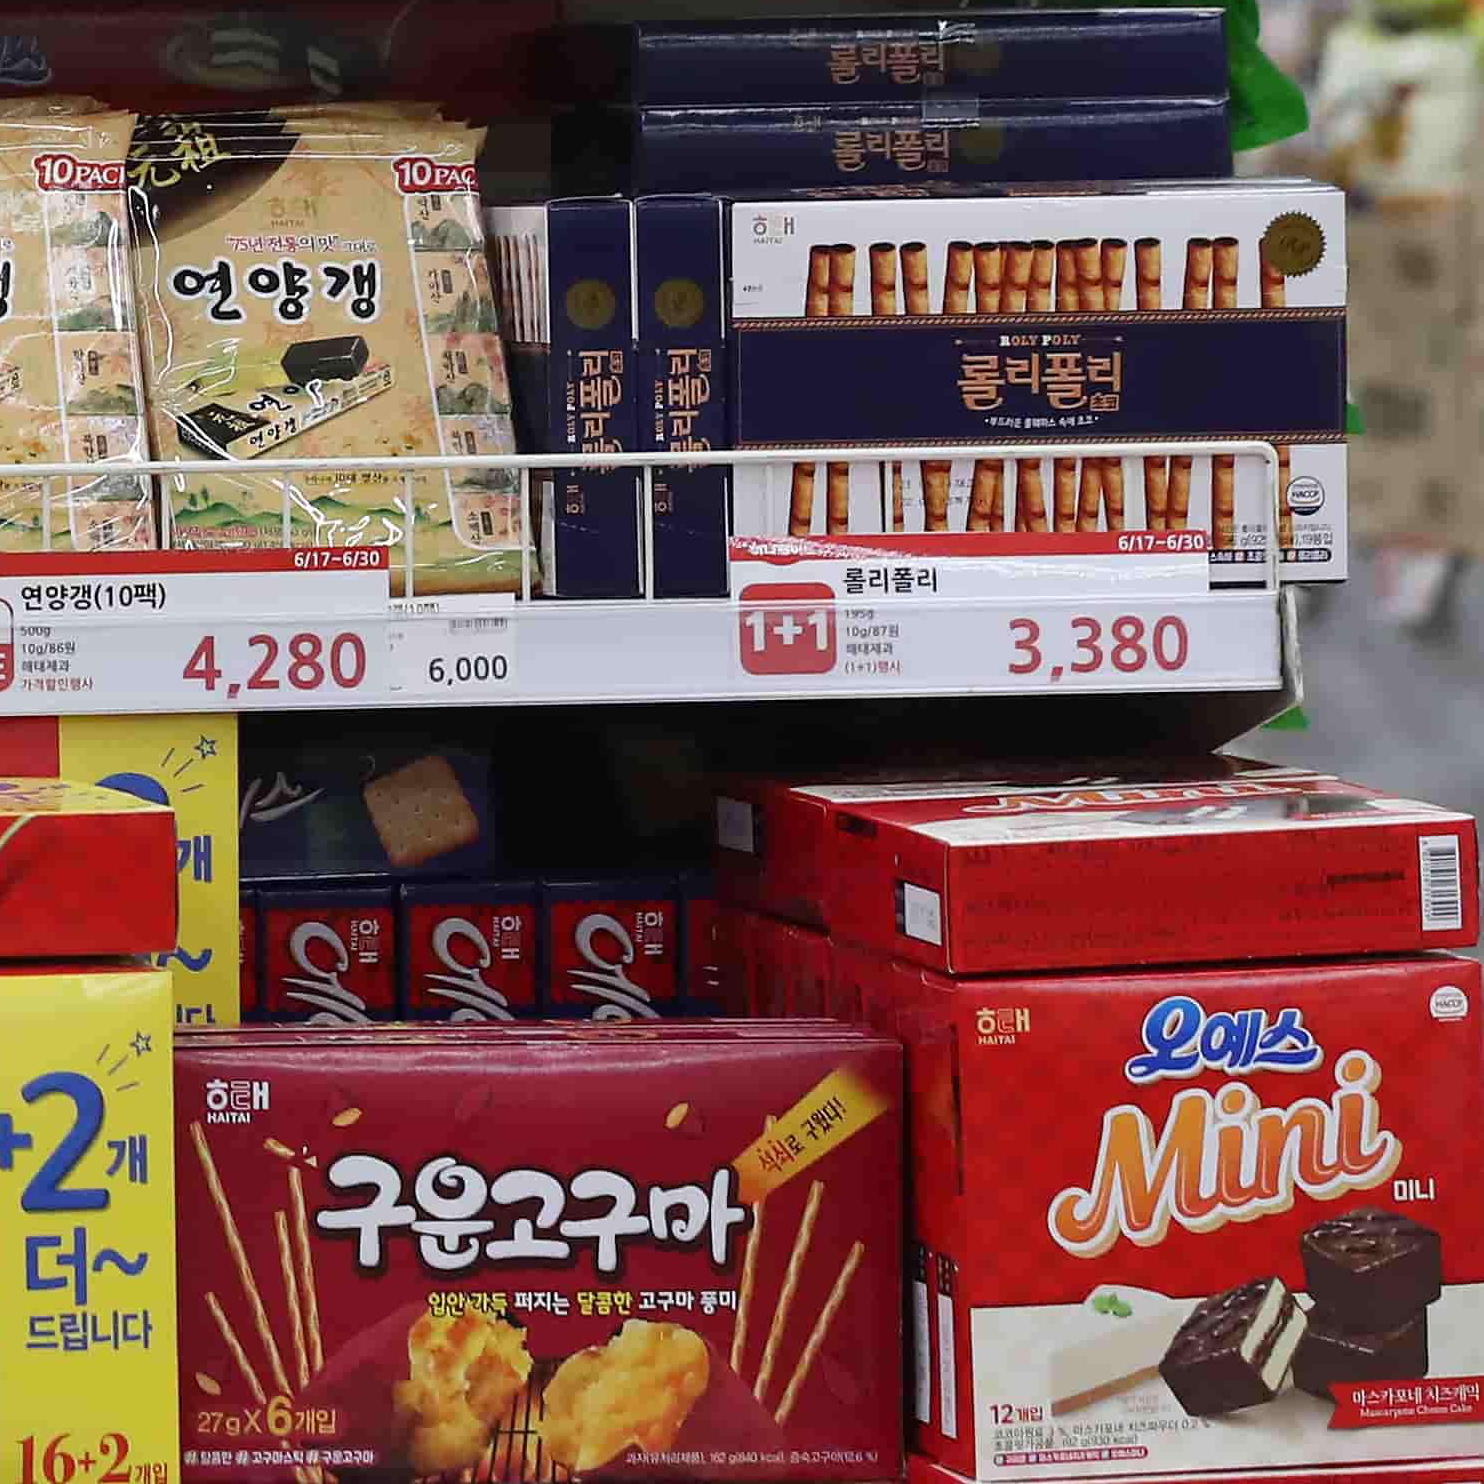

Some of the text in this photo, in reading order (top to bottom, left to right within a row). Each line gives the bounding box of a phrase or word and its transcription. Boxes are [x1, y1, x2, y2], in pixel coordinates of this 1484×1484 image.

[829, 42, 945, 84] 롤리폴리
[833, 128, 951, 172] 롤리폴리
[267, 235, 317, 253] 전통의
[173, 260, 377, 320] 연양갱
[999, 334, 1081, 346] ROLY POLY
[957, 351, 1123, 411] 롤리폴리
[1118, 532, 1205, 553] 6/17~6/30
[293, 549, 381, 570] 6/17~6/30
[843, 567, 938, 594] 롤리폴리
[21, 583, 167, 612] 연양갱(10팩)
[745, 610, 830, 653] 1+1
[1008, 614, 1190, 683] 3,380
[182, 630, 368, 700] 4,280
[428, 655, 508, 686] 6,000
[979, 1035, 1017, 1045] HAITAI
[1125, 996, 1321, 1083] 오예스
[207, 1113, 251, 1124] HAITAI
[1047, 1050, 1401, 1260] Mini
[1393, 1177, 1435, 1202] 미니
[317, 1153, 746, 1272] 구운고구마
[514, 1292, 571, 1315] 퍼지는
[577, 1291, 632, 1316] 달콤한
[638, 1290, 696, 1313] 고구마
[699, 1290, 737, 1315] 풍미
[24, 1312, 153, 1350] 드립니다
[1352, 1383, 1480, 1406] 마스카포네 치즈케익
[989, 1403, 1045, 1425] 12개입
